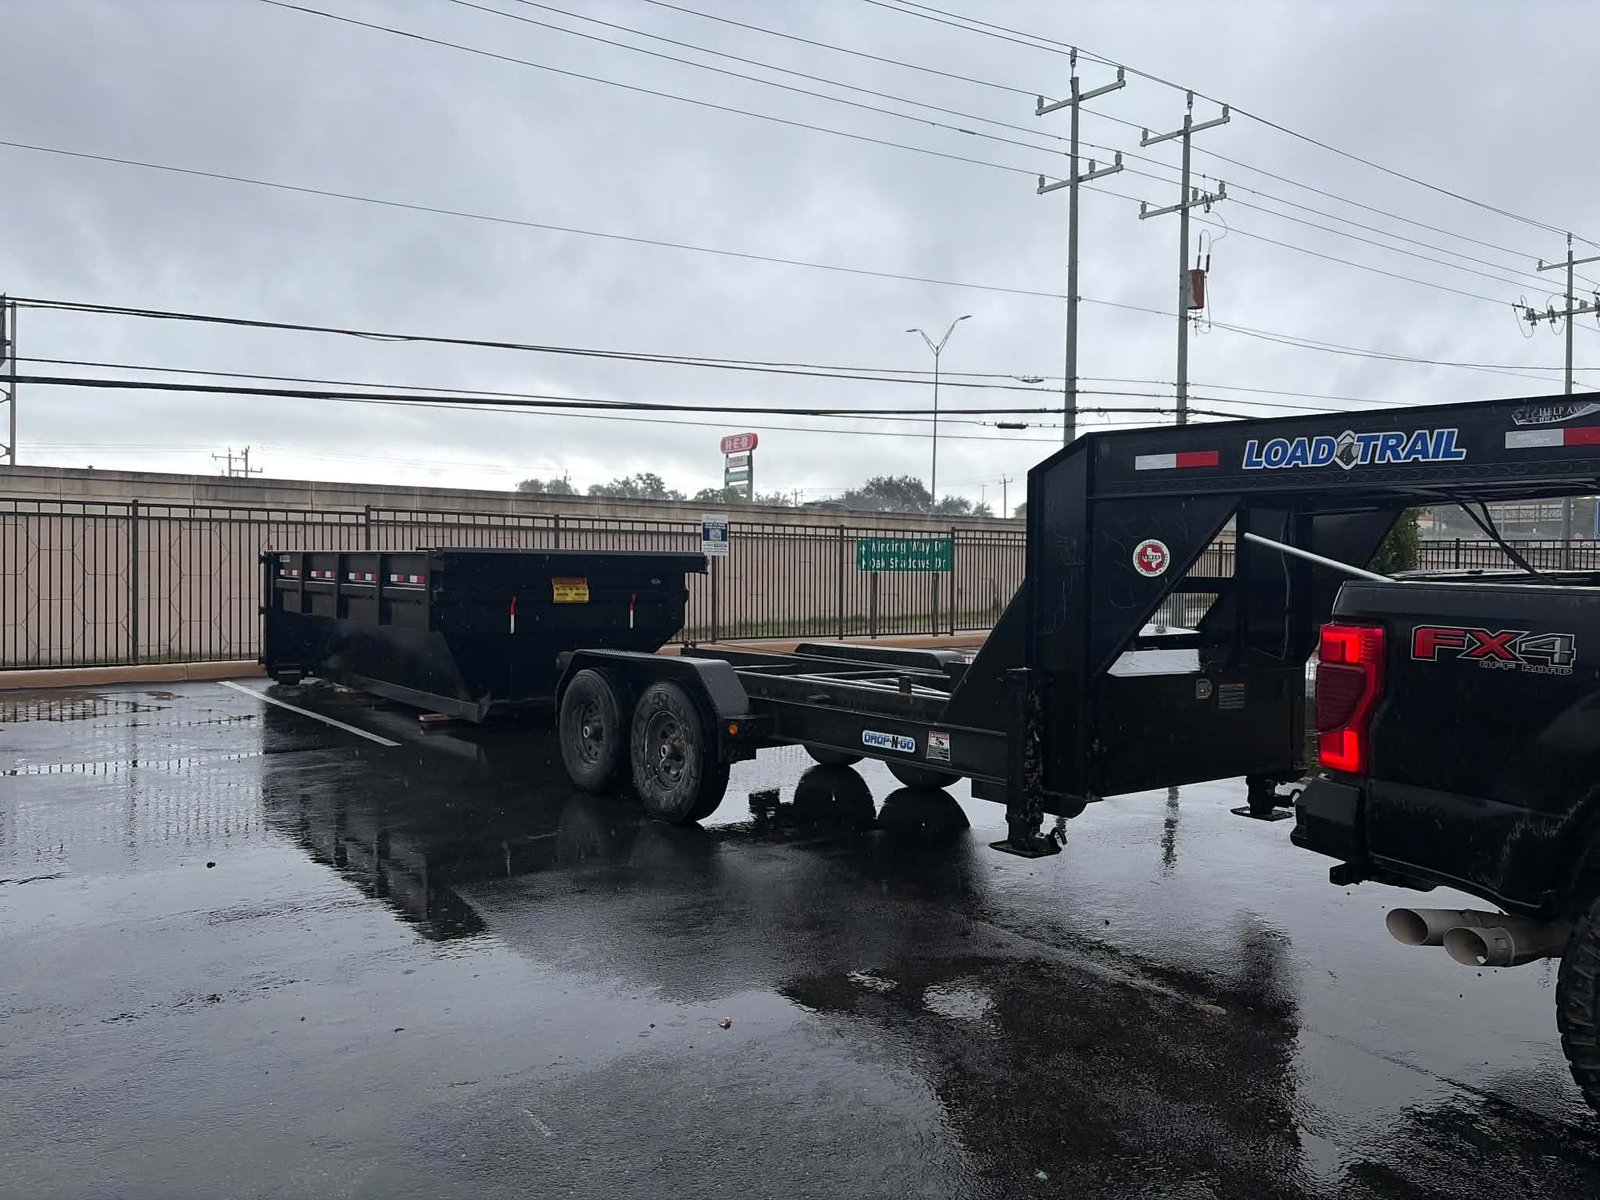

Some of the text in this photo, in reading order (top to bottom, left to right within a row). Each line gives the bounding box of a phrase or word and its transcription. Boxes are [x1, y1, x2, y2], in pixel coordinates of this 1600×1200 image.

[1539, 406, 1564, 416] HELP
[1242, 429, 1466, 469] LOAD TRAIL
[1411, 625, 1577, 667] FX4
[1480, 660, 1573, 676] OFF ROAD
